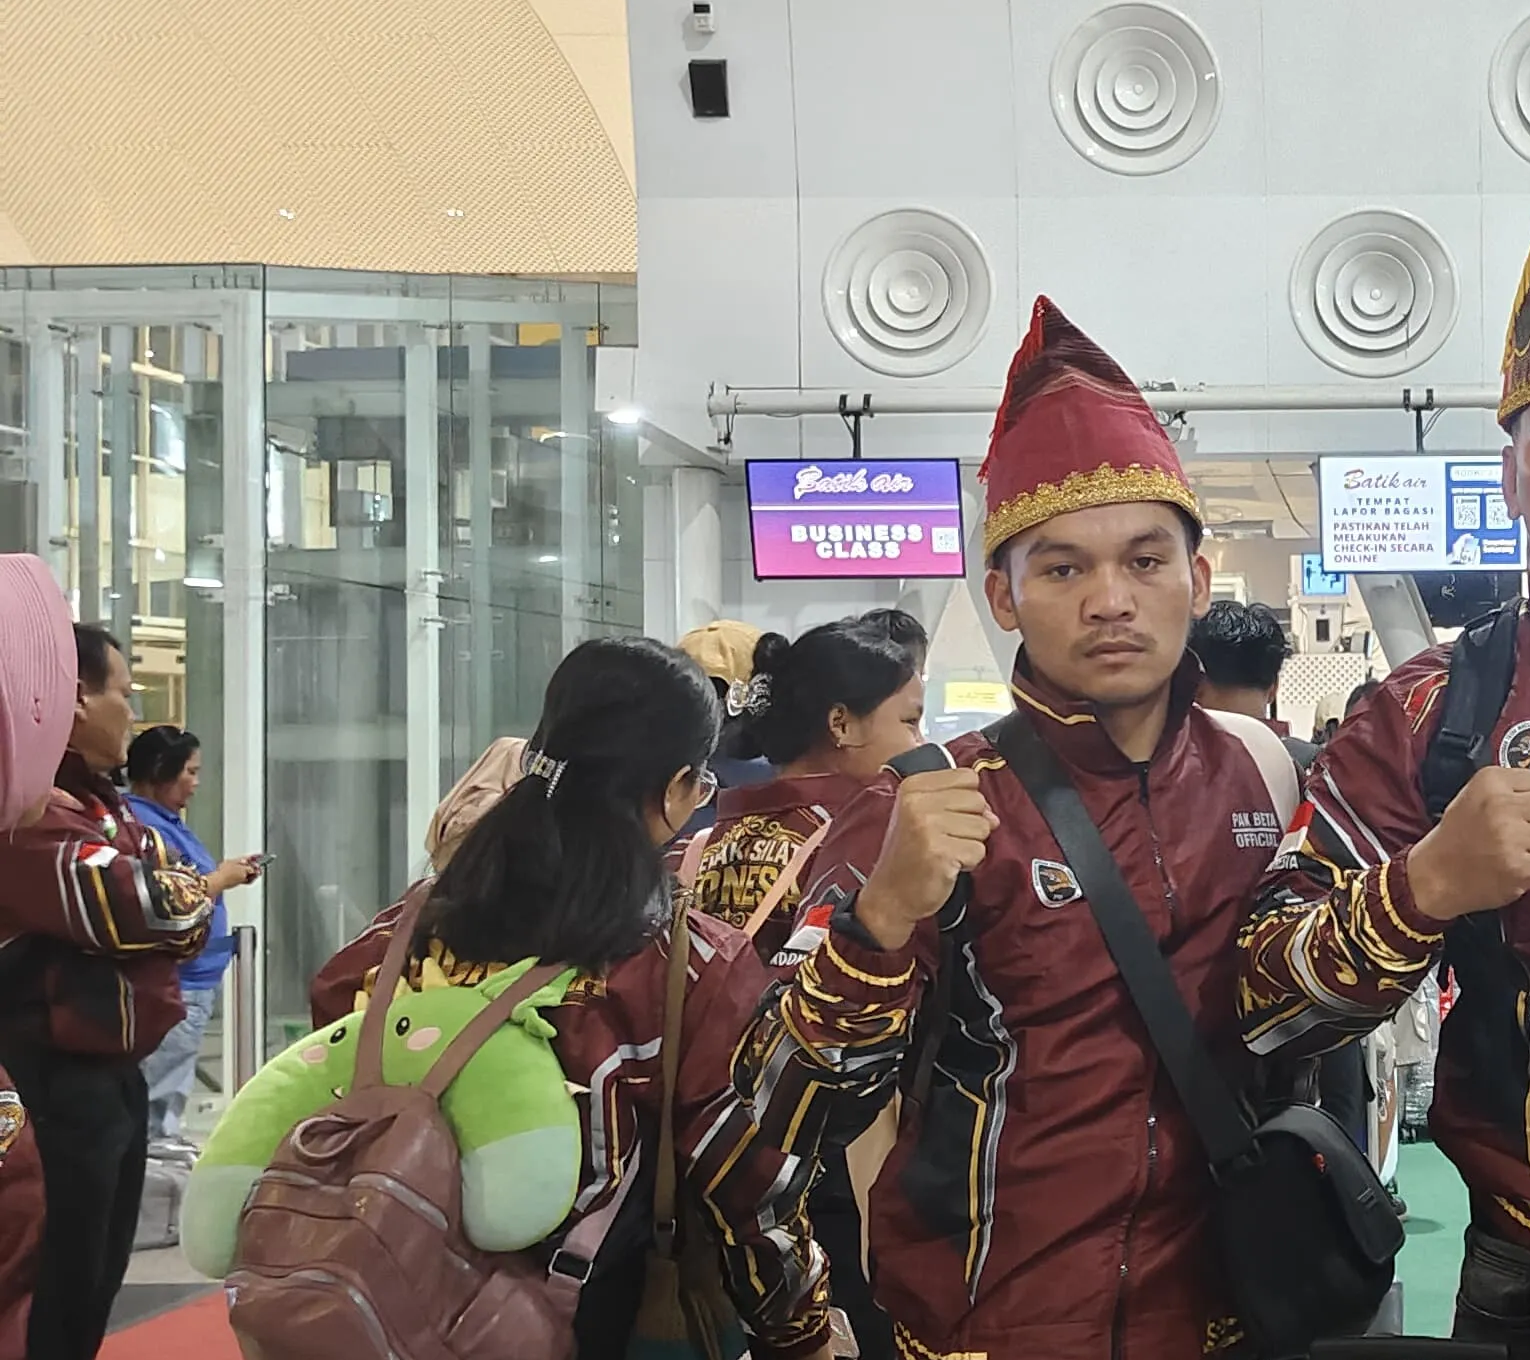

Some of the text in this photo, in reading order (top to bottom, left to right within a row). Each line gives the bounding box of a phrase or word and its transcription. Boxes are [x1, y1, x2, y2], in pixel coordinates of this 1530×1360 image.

[794, 466, 868, 500] Batik
[1344, 468, 1428, 490] Batik air
[1357, 497, 1410, 506] TEMPAT
[1333, 507, 1434, 516] LAPOR BAGASI
[1333, 521, 1430, 531] PASTIKAN TELAH
[791, 524, 923, 542] BUSINESS
[1333, 533, 1407, 542] MELAKUKAN
[816, 541, 901, 559] CLASS
[1333, 543, 1435, 553] CHECK-IN SECARA
[1333, 555, 1378, 563] ONLINE
[1231, 811, 1278, 827] PAK BETA
